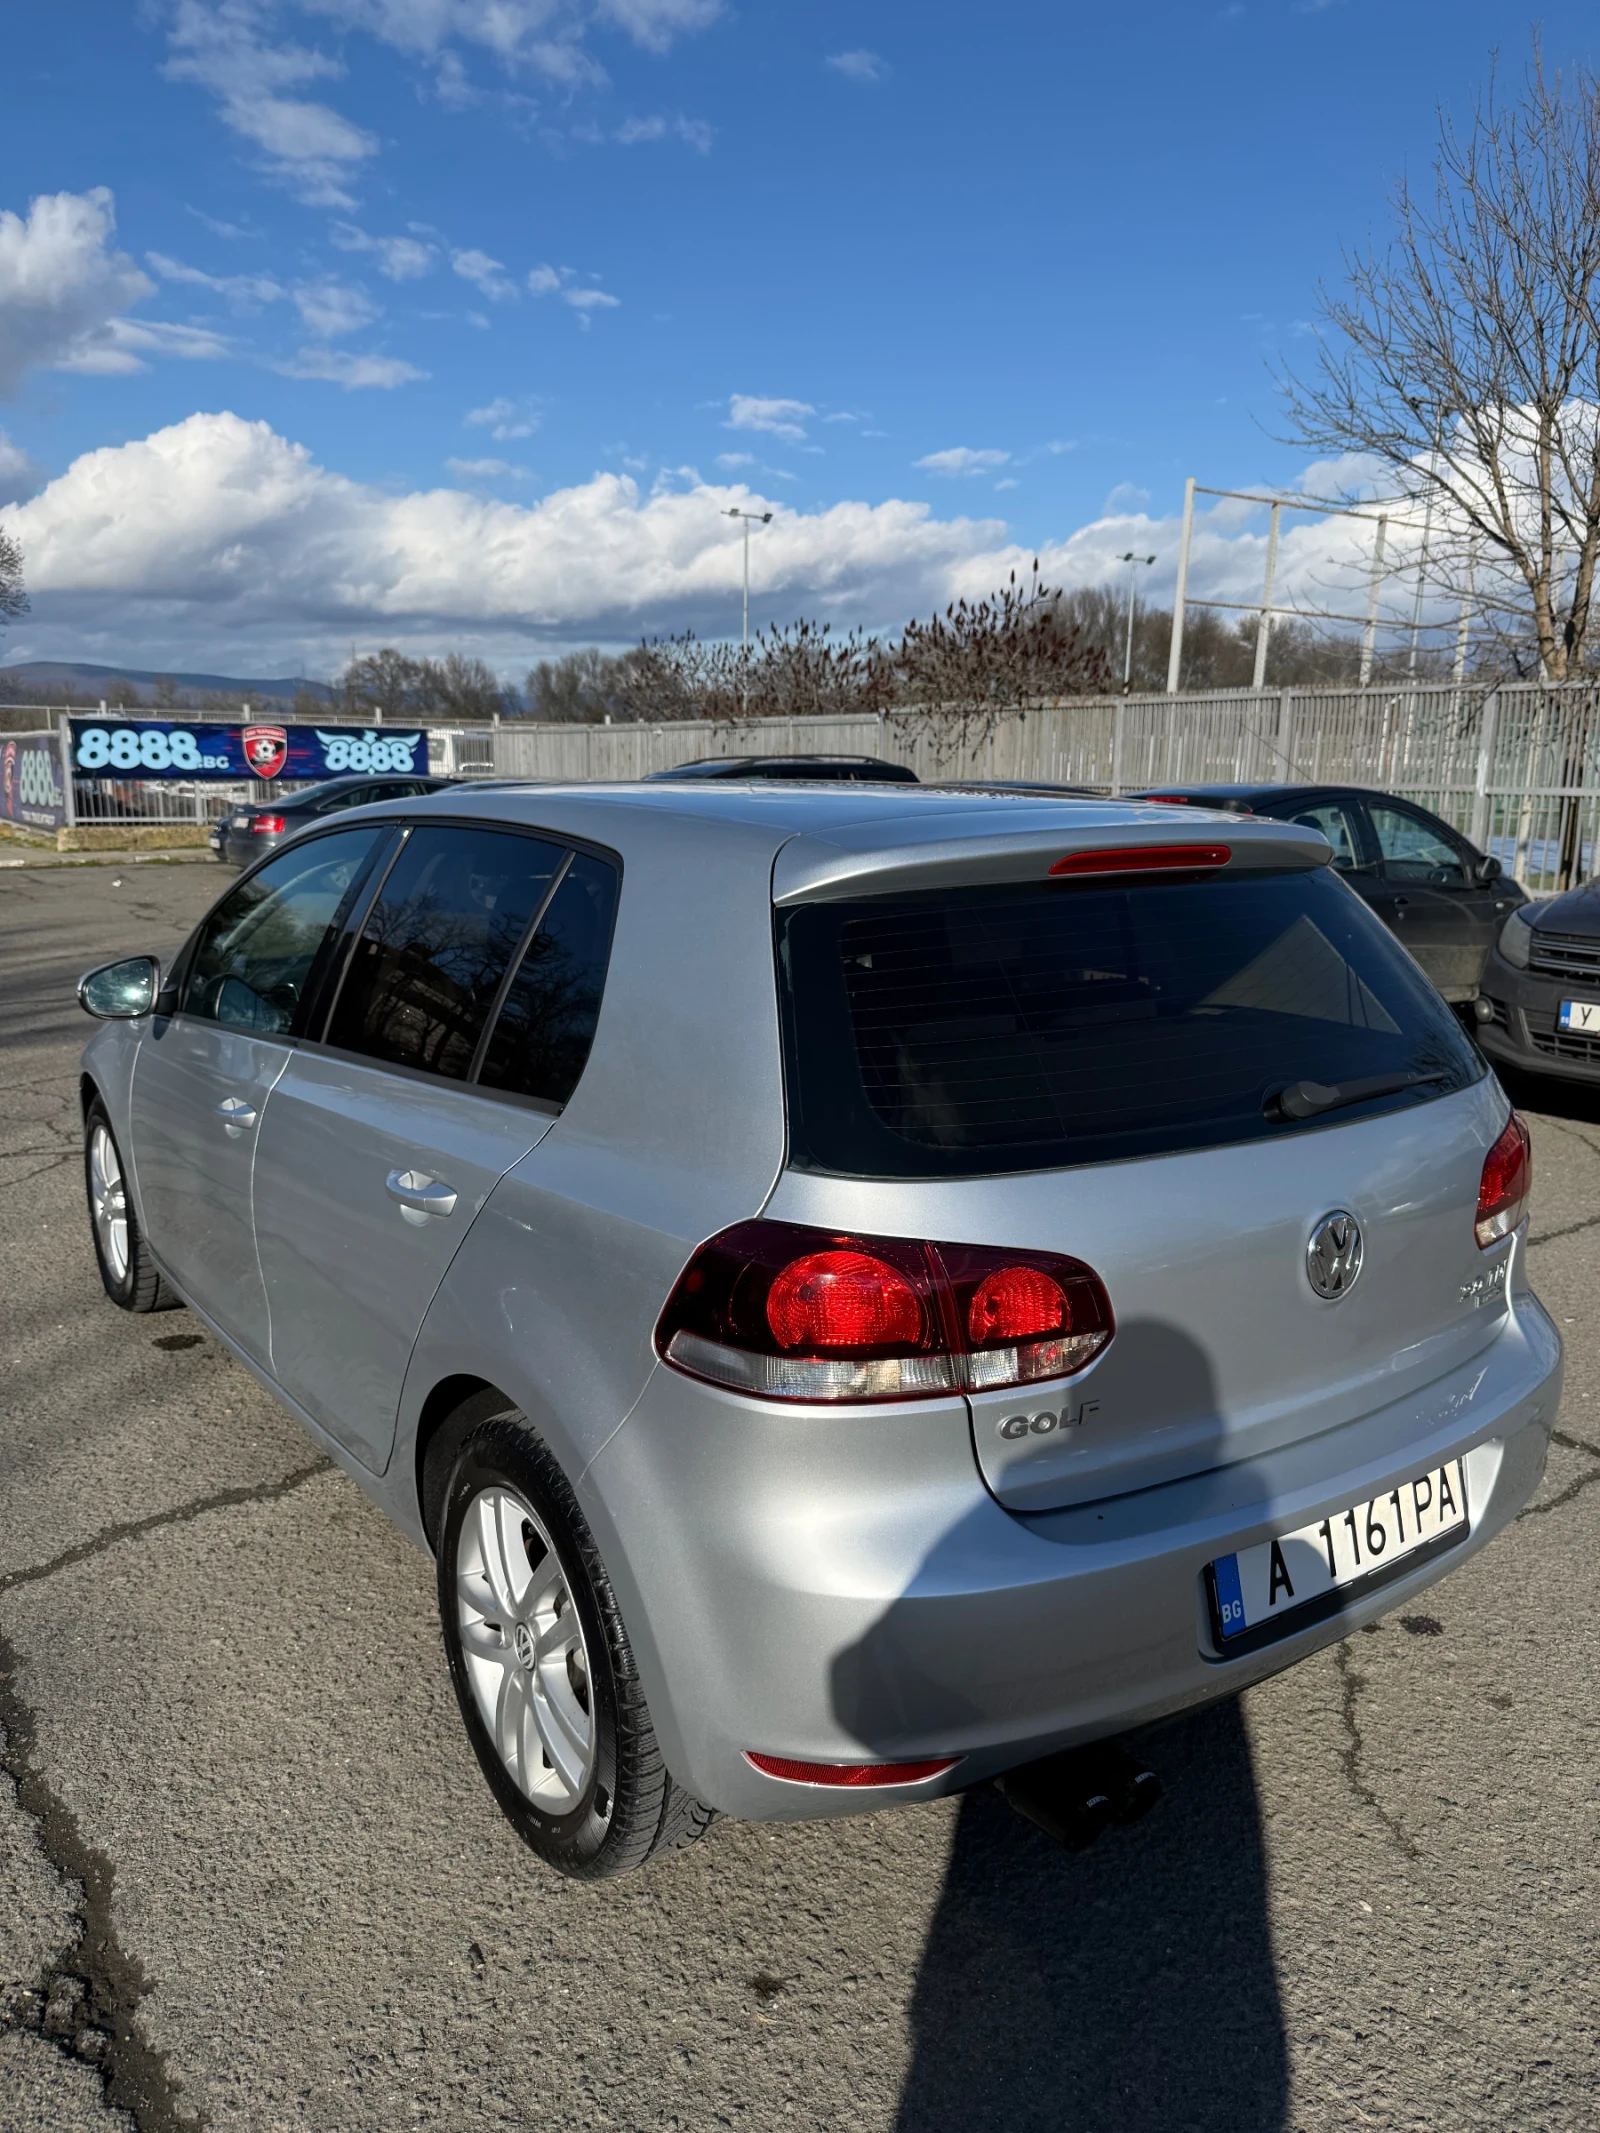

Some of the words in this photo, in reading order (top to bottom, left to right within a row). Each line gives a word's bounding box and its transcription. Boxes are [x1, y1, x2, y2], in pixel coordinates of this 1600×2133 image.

[325, 740, 414, 772] 8888
[1000, 1400, 1100, 1439] GOLF
[1269, 1539, 1294, 1605] A
[1221, 1600, 1241, 1623] BG
